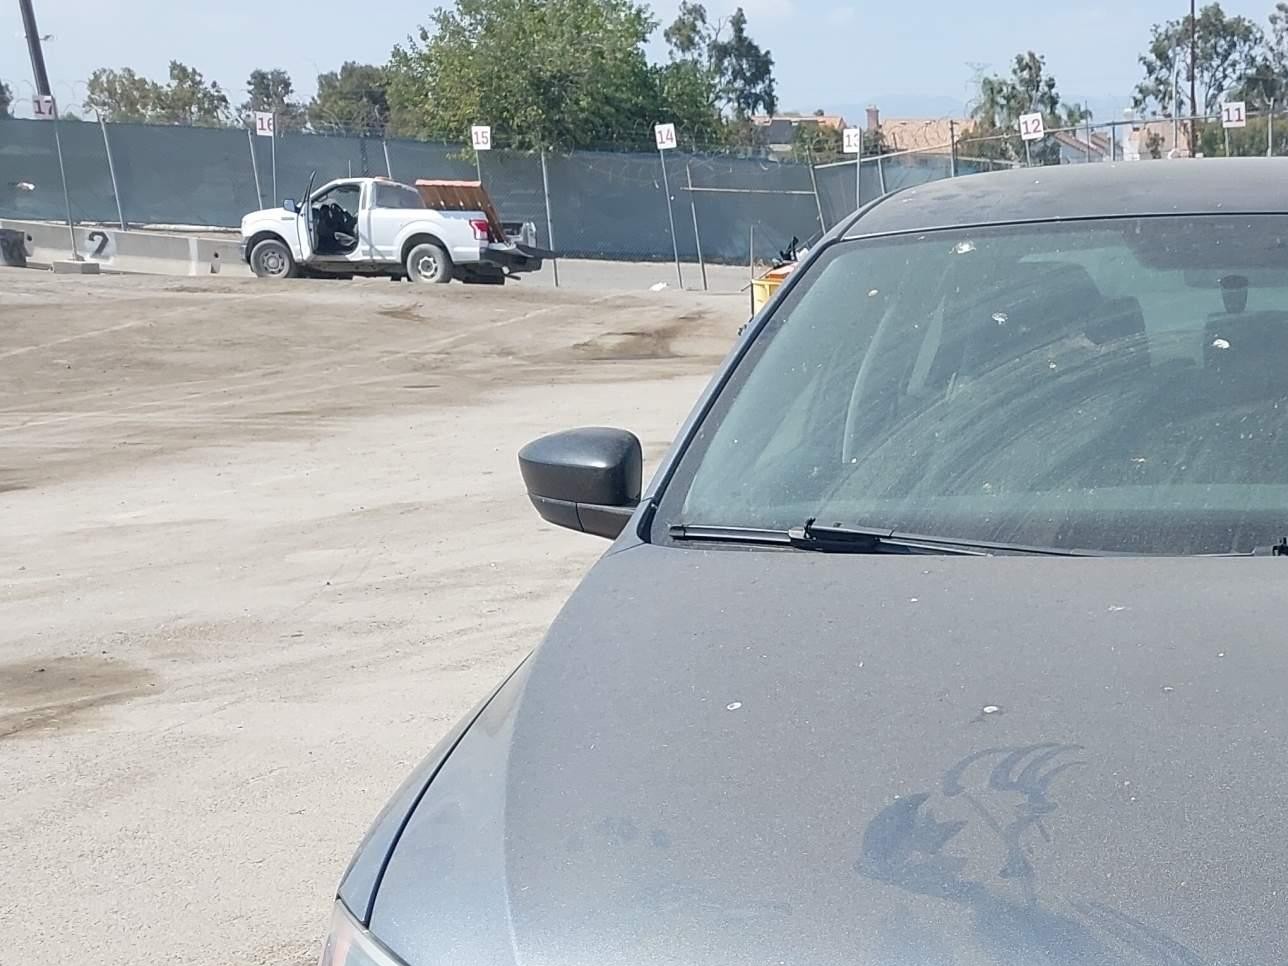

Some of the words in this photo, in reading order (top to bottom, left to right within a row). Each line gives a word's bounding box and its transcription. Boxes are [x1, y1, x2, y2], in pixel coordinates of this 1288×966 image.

[35, 99, 54, 115] 17
[1223, 107, 1244, 122] 11
[1022, 118, 1042, 135] 12
[474, 131, 489, 145] 15
[657, 128, 674, 145] 14
[87, 230, 111, 259] 2
